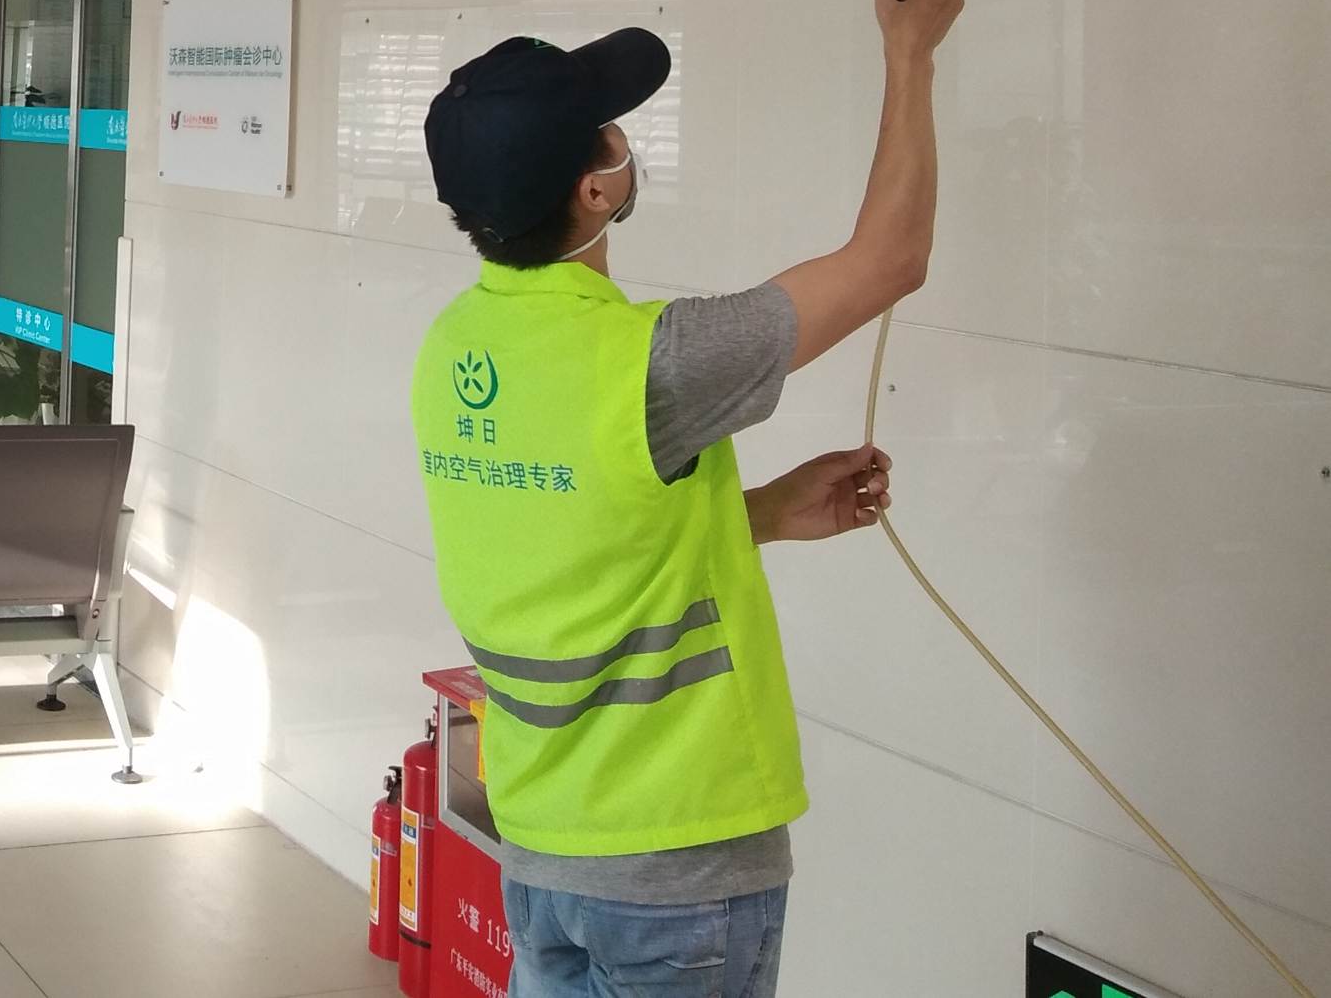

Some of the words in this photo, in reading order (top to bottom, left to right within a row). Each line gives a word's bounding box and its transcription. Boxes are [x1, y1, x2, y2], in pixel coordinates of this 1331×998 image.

[169, 45, 283, 66] 沃森智能国际肿瘤会诊中心
[16, 307, 51, 331] 特诊中心
[456, 414, 496, 445] 坤日
[486, 918, 511, 958] 119
